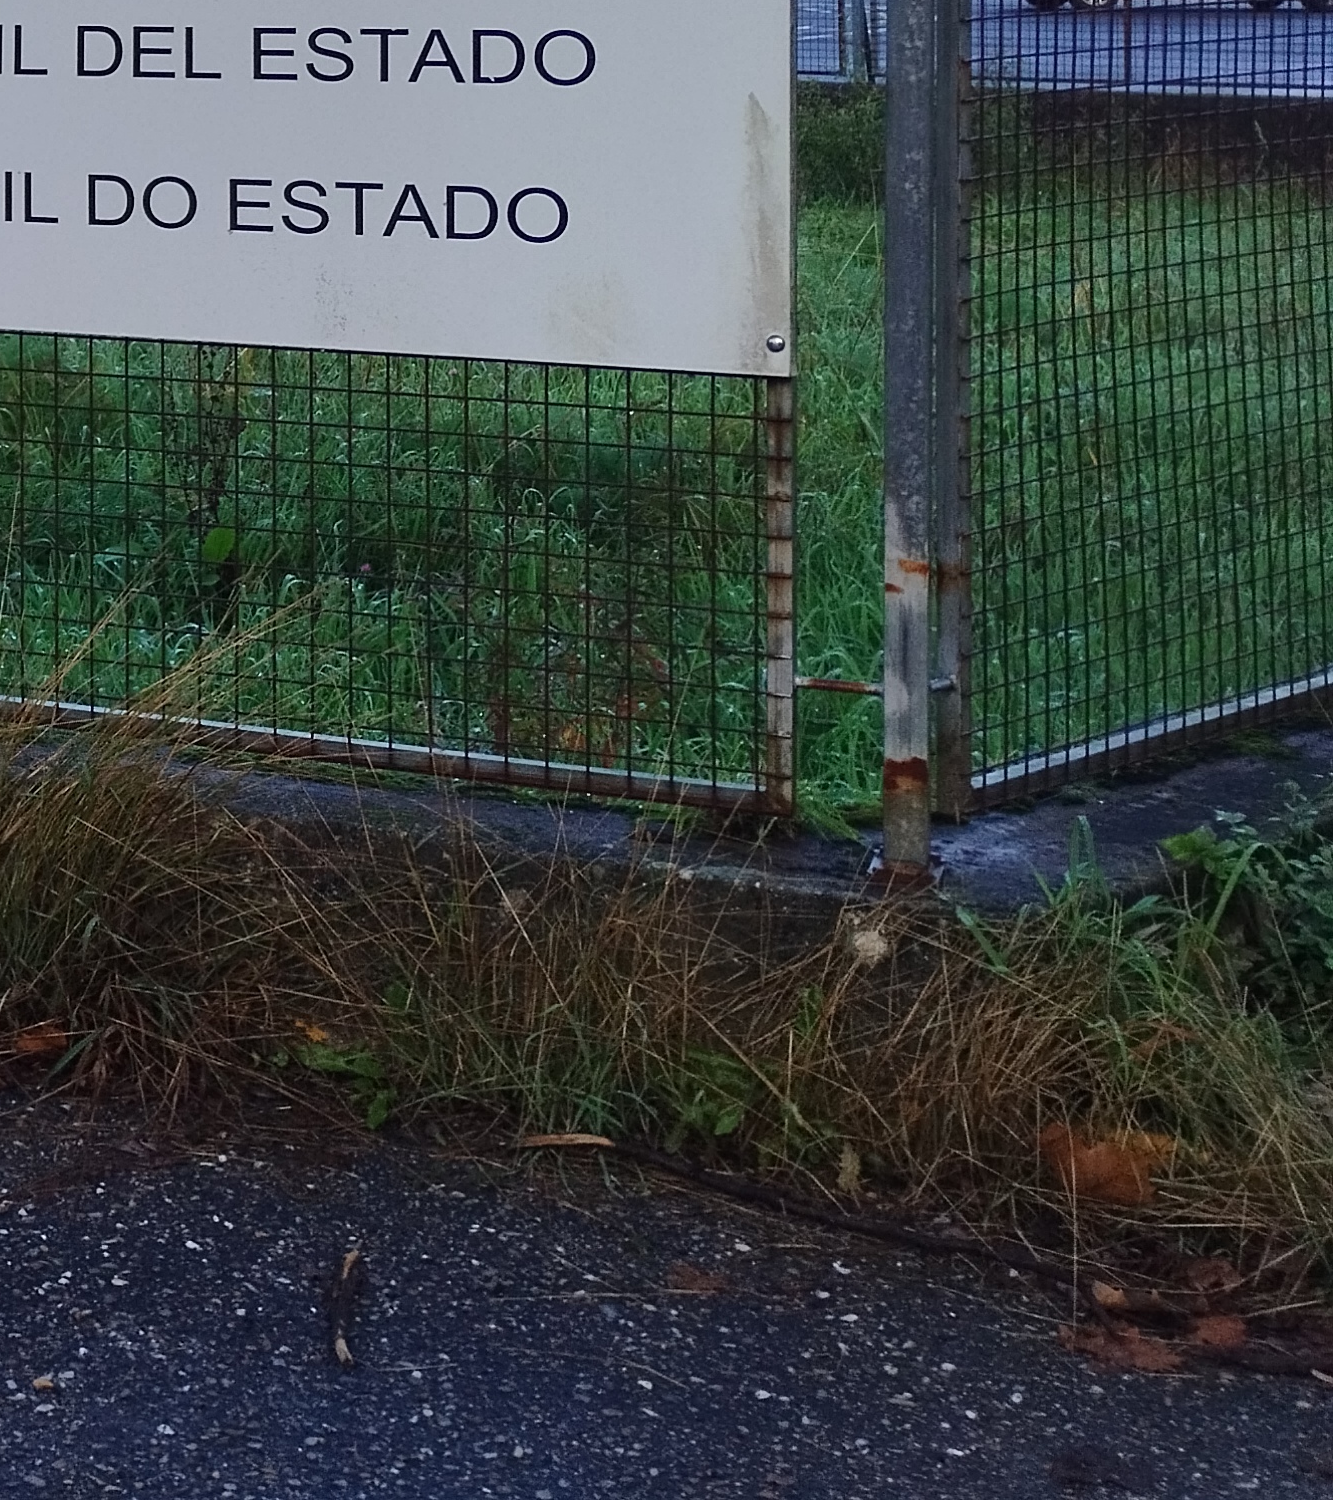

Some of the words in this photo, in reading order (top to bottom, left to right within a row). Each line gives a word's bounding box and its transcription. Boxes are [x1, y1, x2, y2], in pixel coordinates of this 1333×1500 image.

[76, 25, 222, 80] DEL
[252, 27, 596, 87] ESTADO
[87, 173, 198, 230] DO
[229, 178, 569, 244] ESTADO
